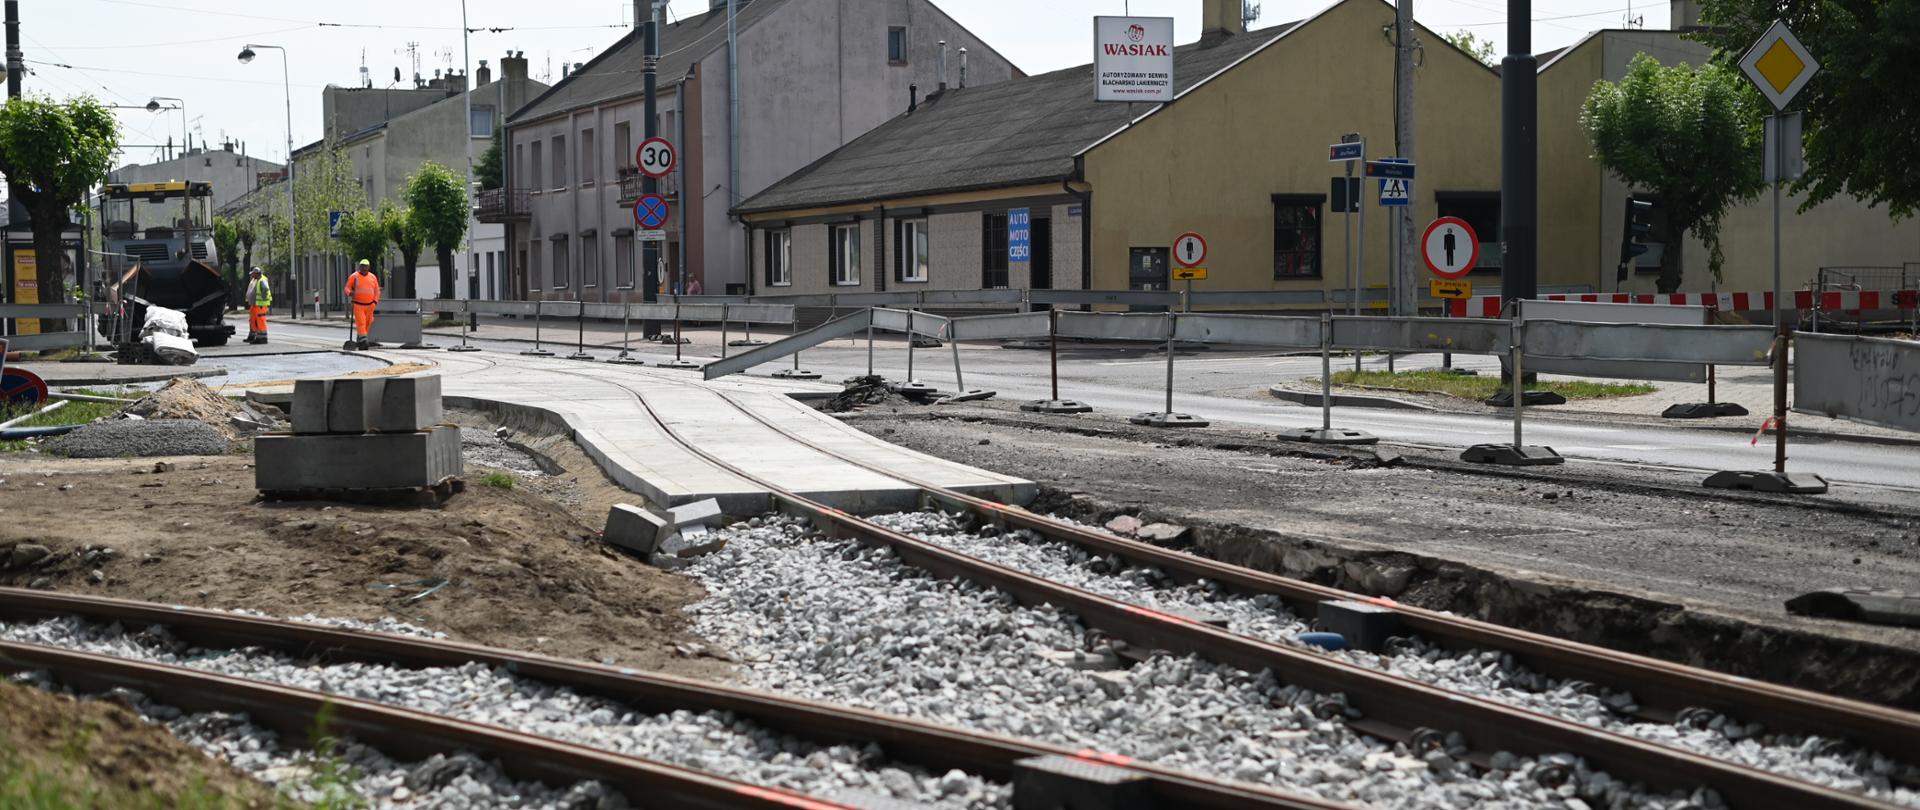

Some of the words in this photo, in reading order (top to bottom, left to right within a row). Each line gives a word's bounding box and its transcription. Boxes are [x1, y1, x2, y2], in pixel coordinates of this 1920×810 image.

[1104, 44, 1168, 56] WASIAK
[643, 147, 671, 167] 30
[1010, 213, 1028, 224] AUTO
[1010, 230, 1028, 240] MOTO
[1009, 243, 1028, 260] CZĘŚCI
